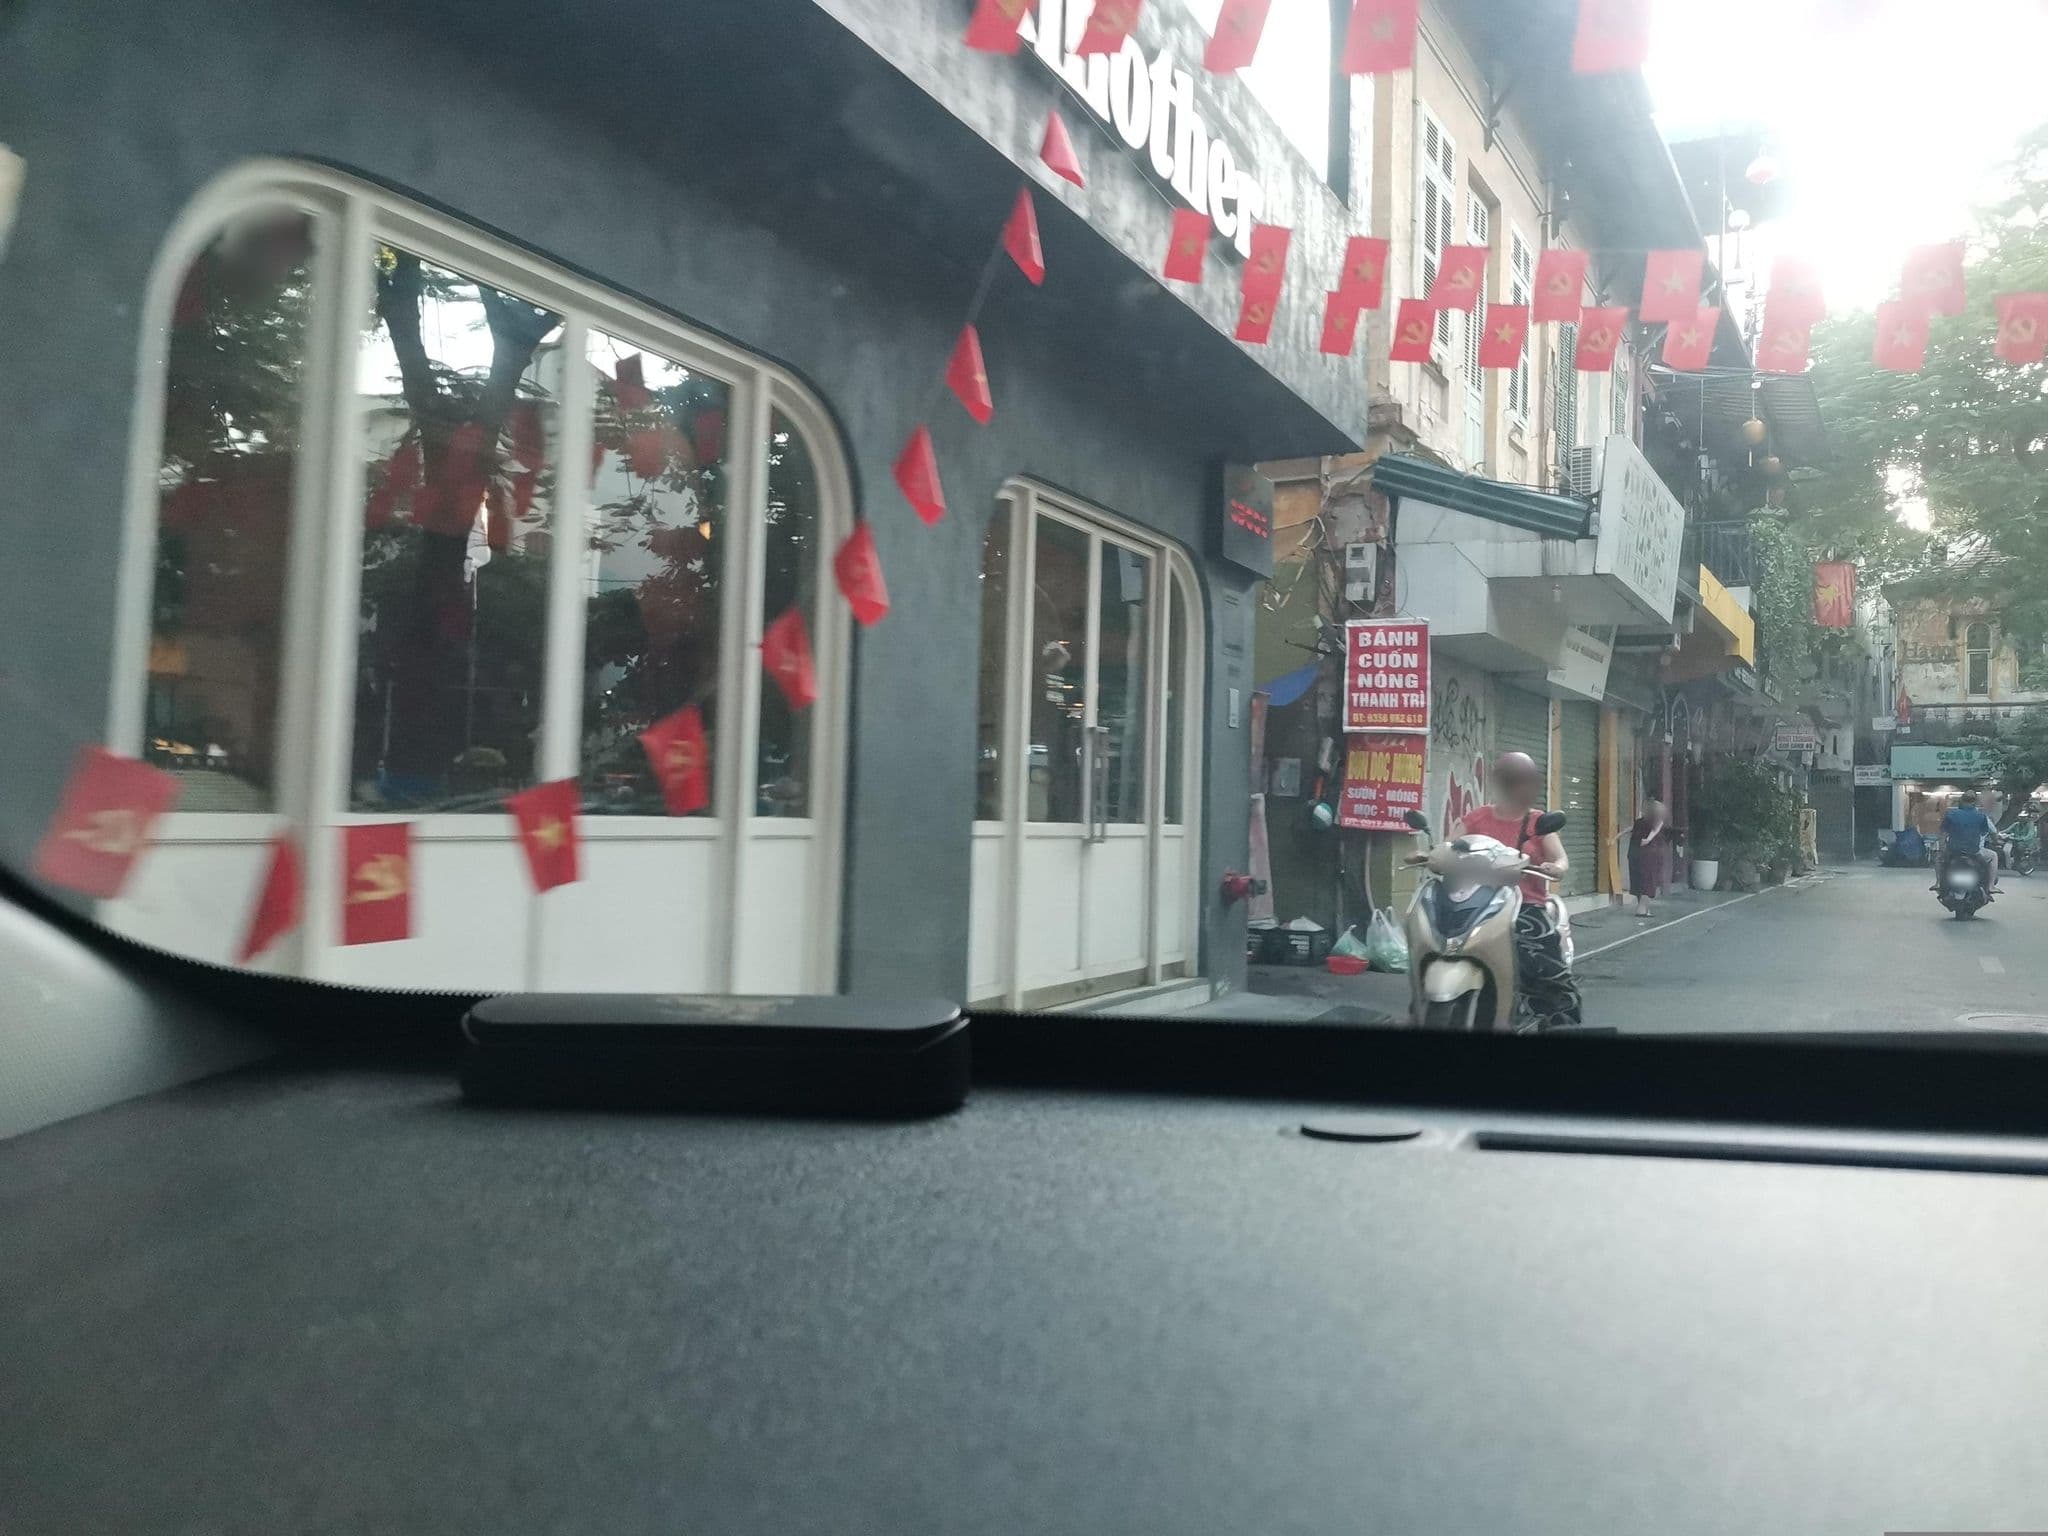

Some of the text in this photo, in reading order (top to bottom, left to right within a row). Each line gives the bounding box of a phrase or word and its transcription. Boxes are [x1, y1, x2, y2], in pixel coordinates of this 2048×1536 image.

[1015, 0, 1264, 260] nother
[1359, 629, 1418, 647] BÁNH
[1359, 648, 1418, 668] CUỐN
[1358, 670, 1419, 688] NÓNG
[1351, 690, 1425, 708] THANH TRÌ
